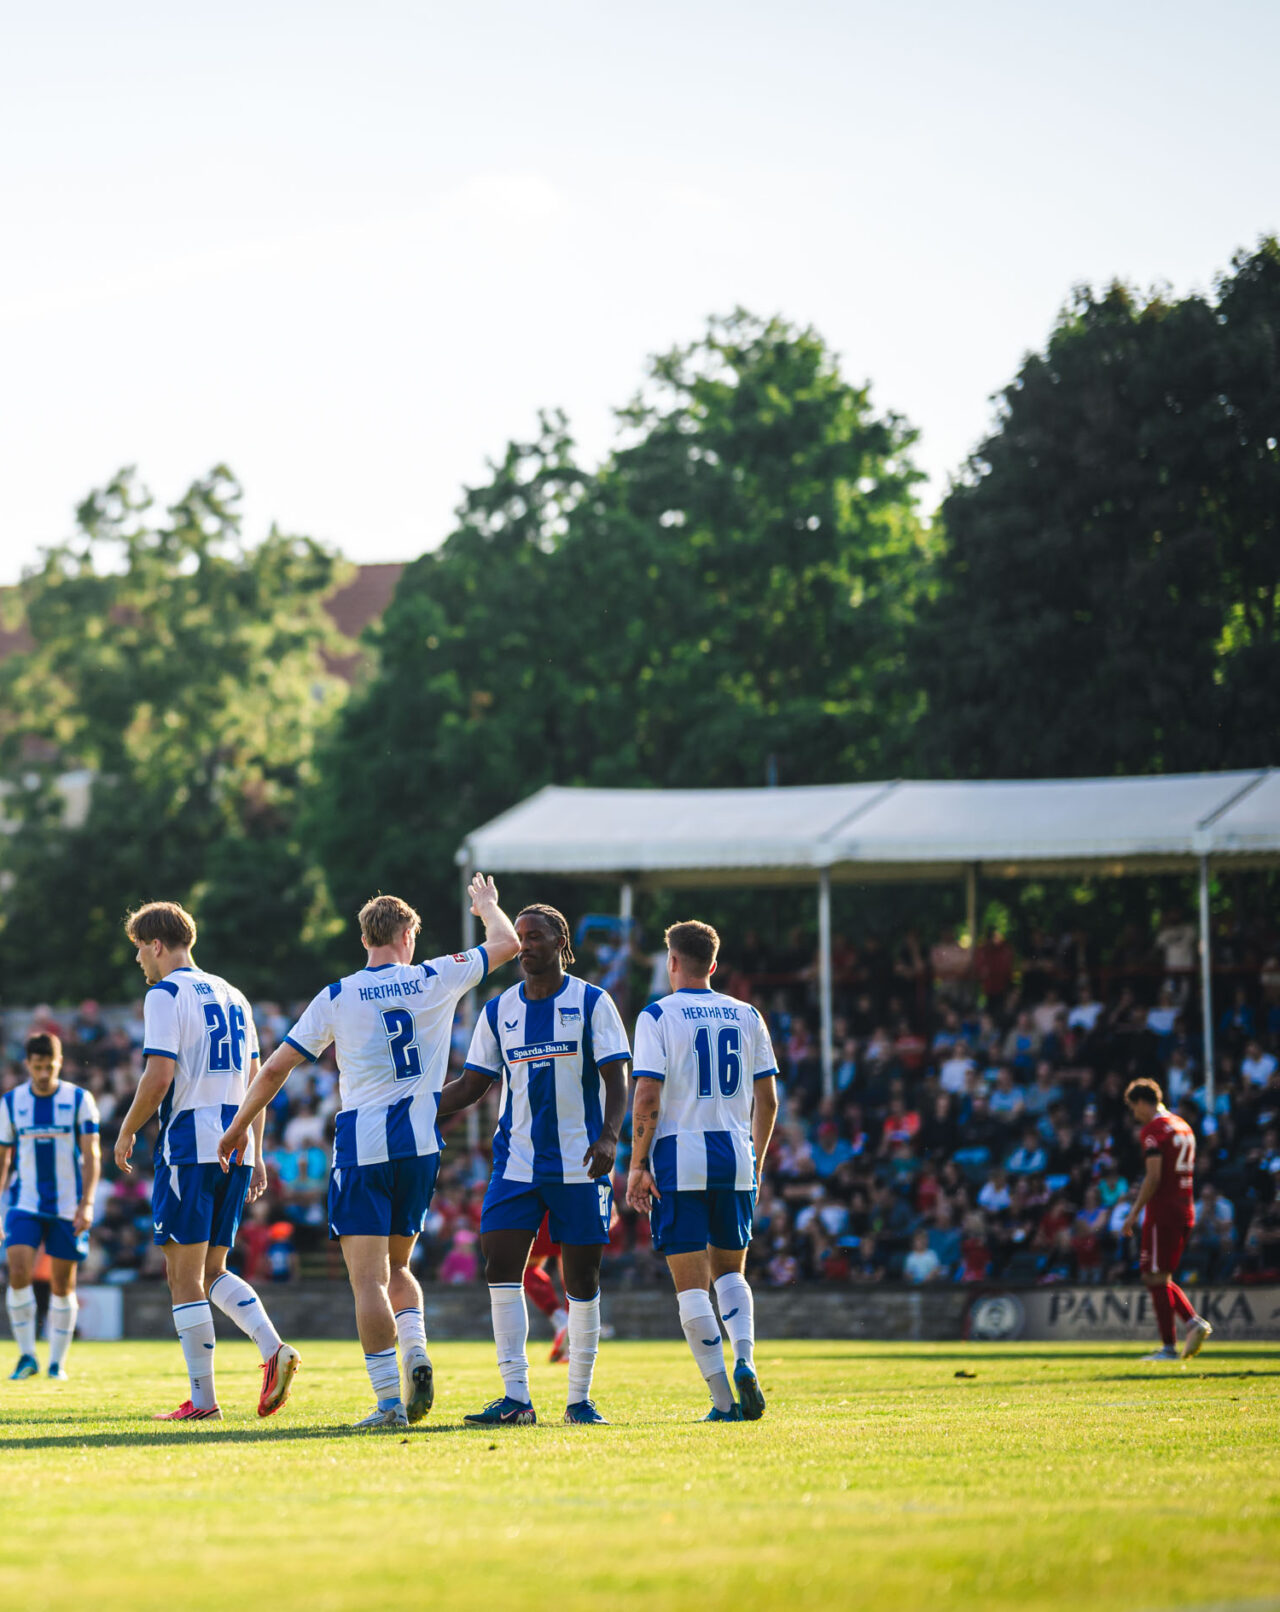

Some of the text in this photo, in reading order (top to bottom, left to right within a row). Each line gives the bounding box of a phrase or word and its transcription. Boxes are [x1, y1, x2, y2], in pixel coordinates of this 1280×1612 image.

[359, 979, 424, 1001] HERTHA BSC
[681, 1006, 740, 1021] HERTHA BSC
[201, 1001, 246, 1073] 26
[380, 1006, 424, 1082] 2
[513, 1044, 569, 1059] Sparda-Bank
[532, 1061, 551, 1069] Berlin
[693, 1025, 742, 1099] 16
[1047, 1288, 1257, 1327] PANEKA
